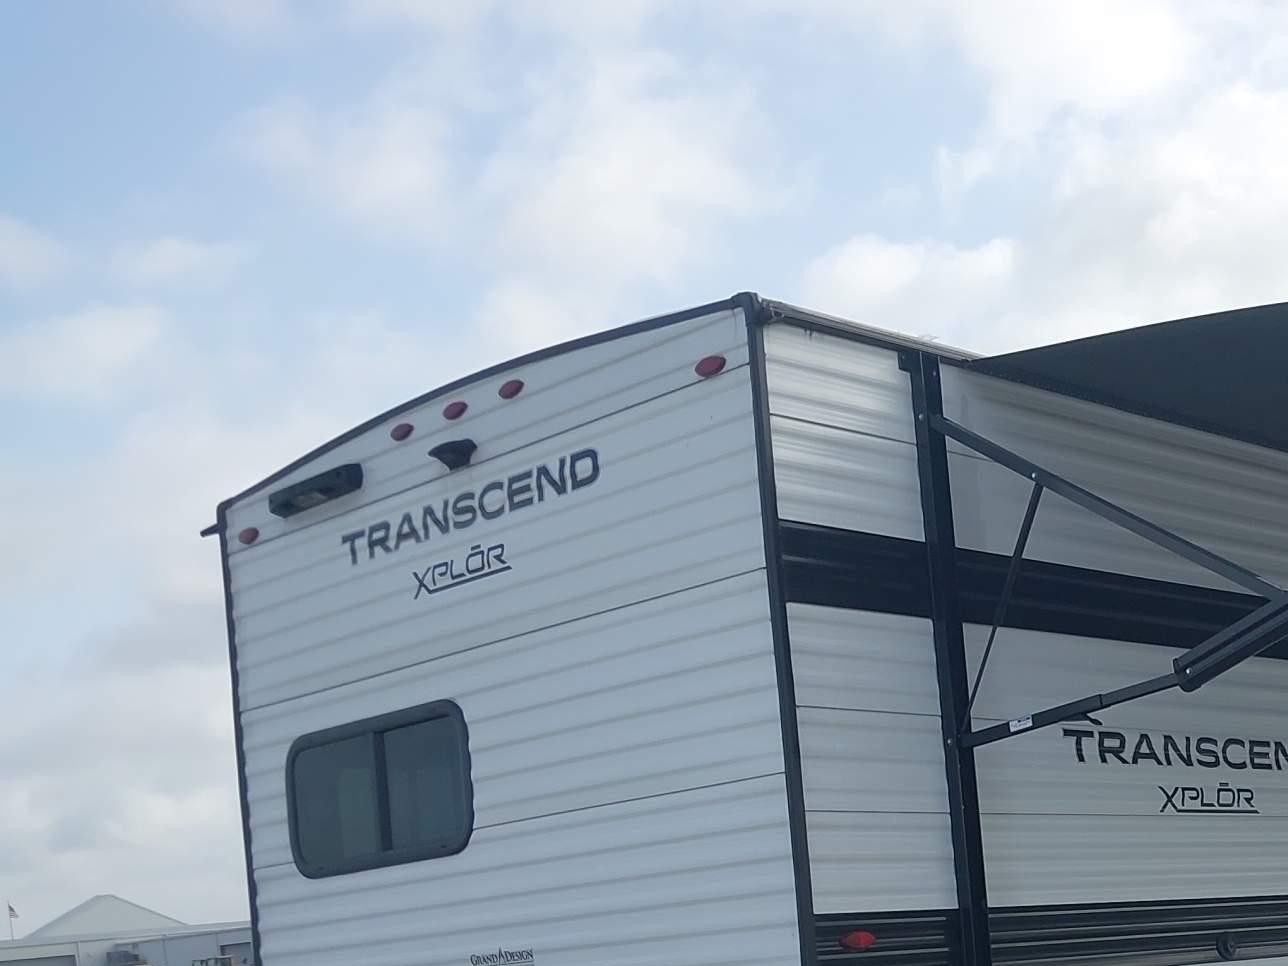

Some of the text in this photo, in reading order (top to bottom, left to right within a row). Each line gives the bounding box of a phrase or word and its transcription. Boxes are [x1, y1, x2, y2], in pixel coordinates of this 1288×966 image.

[342, 447, 600, 565] TRANSCEND
[470, 949, 535, 966] GRAND DESIGN
